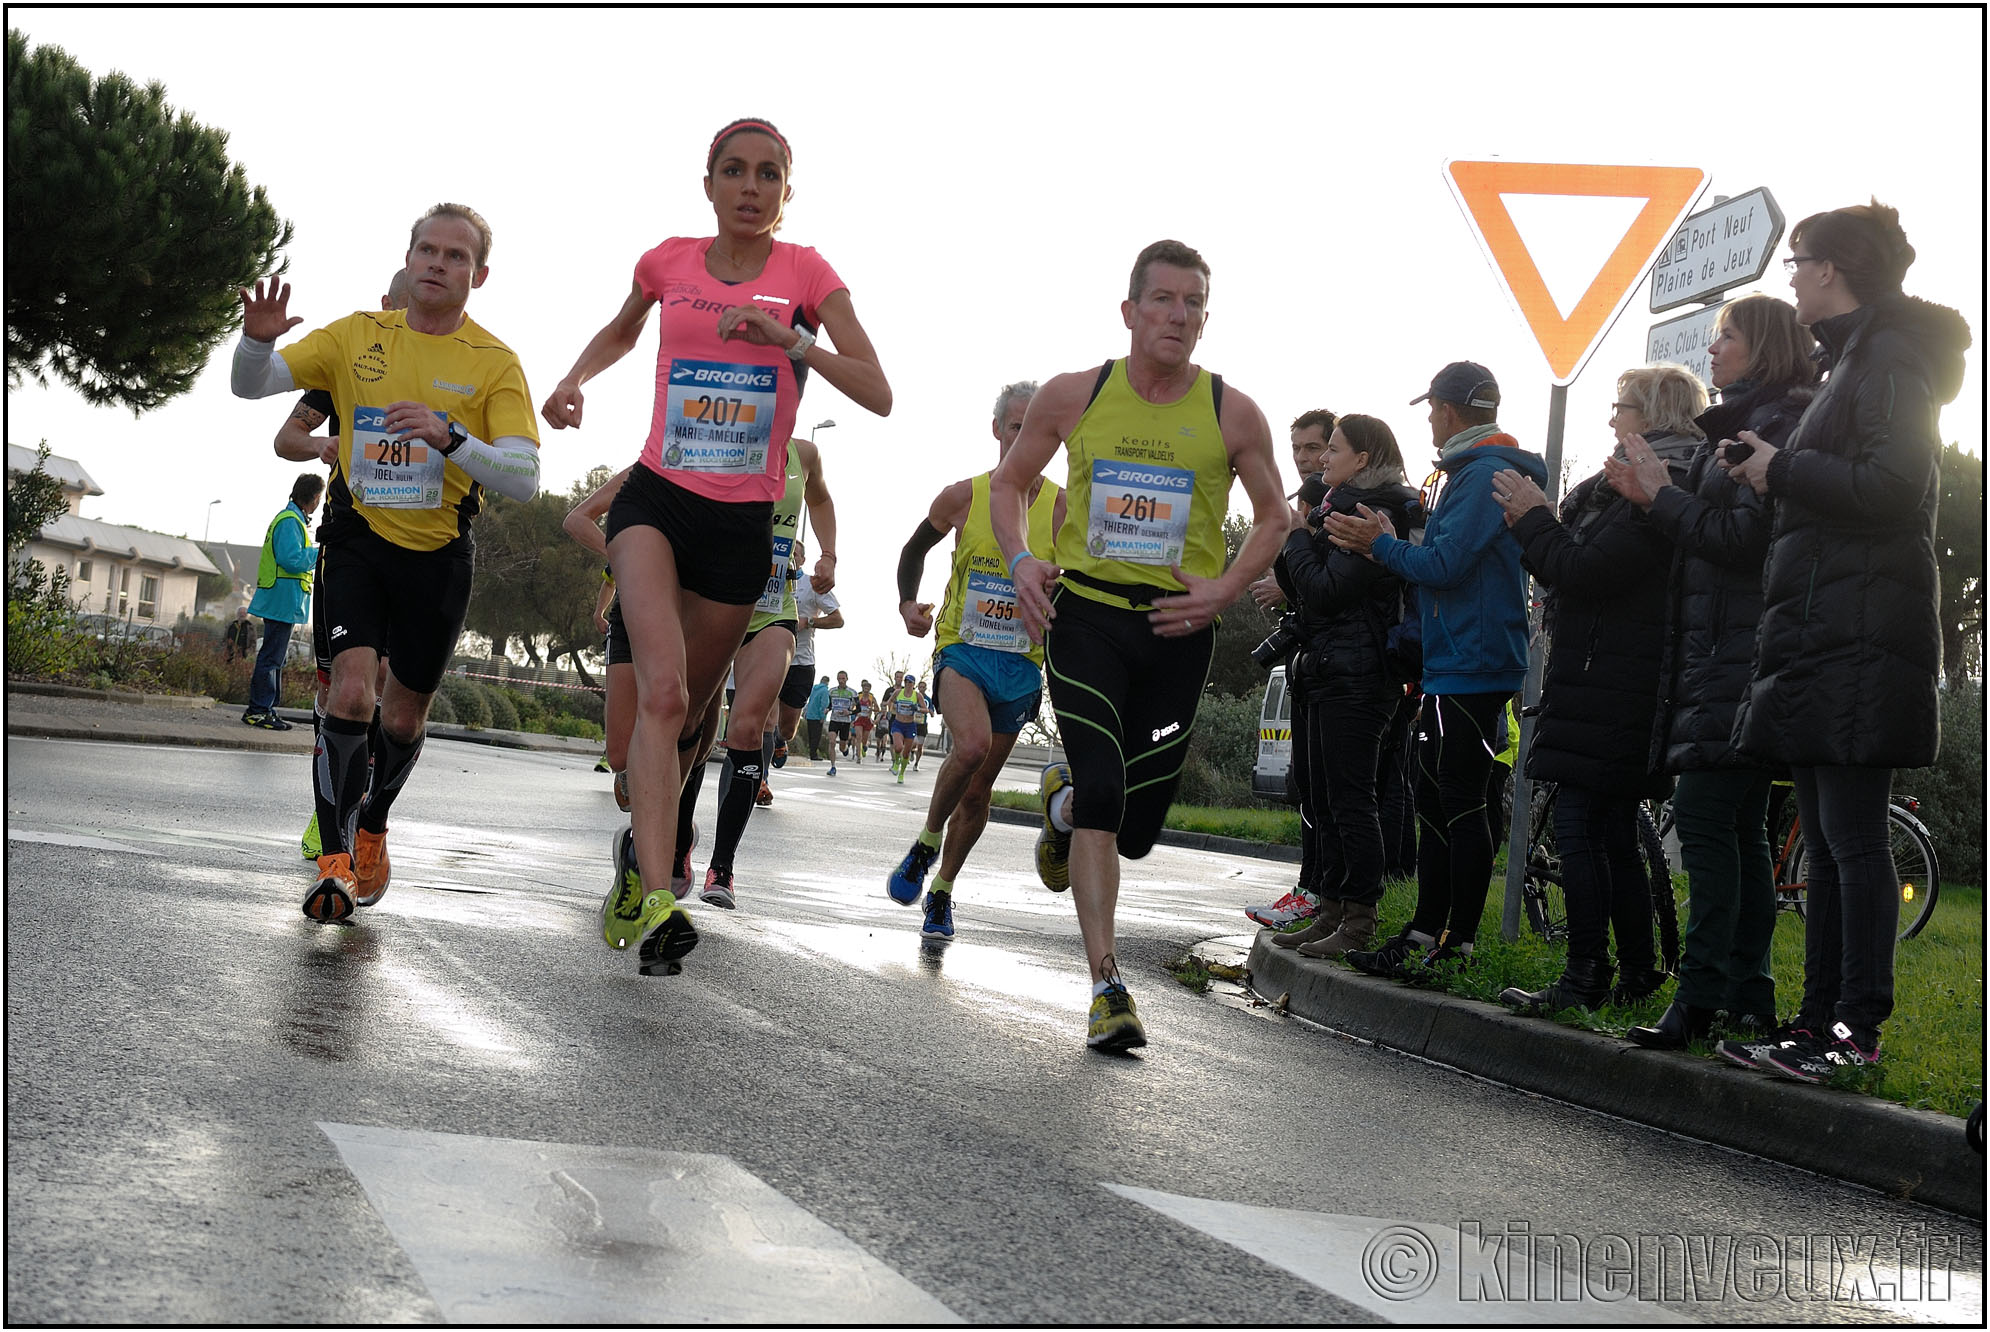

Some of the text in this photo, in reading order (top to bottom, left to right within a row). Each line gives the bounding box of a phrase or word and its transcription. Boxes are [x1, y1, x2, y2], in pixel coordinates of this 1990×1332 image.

[1691, 206, 1754, 252] Port Neuf
[1655, 246, 1753, 297] Plaine de Jeux
[1650, 338, 1672, 362] Rés.
[1675, 328, 1698, 355] Club
[694, 369, 773, 387] BROOKS
[696, 395, 742, 427] 207
[674, 425, 746, 444] MARIE-AMÉLIE
[377, 439, 411, 467] 281
[683, 448, 745, 458] MARATHON
[1114, 446, 1175, 462] TRANSPORT VALDELYS
[374, 468, 393, 481] JOEL
[1117, 470, 1189, 488] BROOKS
[366, 486, 420, 495] MARATHON
[425, 490, 439, 498] 29
[1120, 493, 1157, 523] 261
[1103, 520, 1140, 536] THIERRY
[1106, 541, 1162, 550] MARATHON
[984, 598, 1015, 621] 255
[979, 619, 1001, 631] LIONEL
[975, 632, 1015, 641] MARATHON
